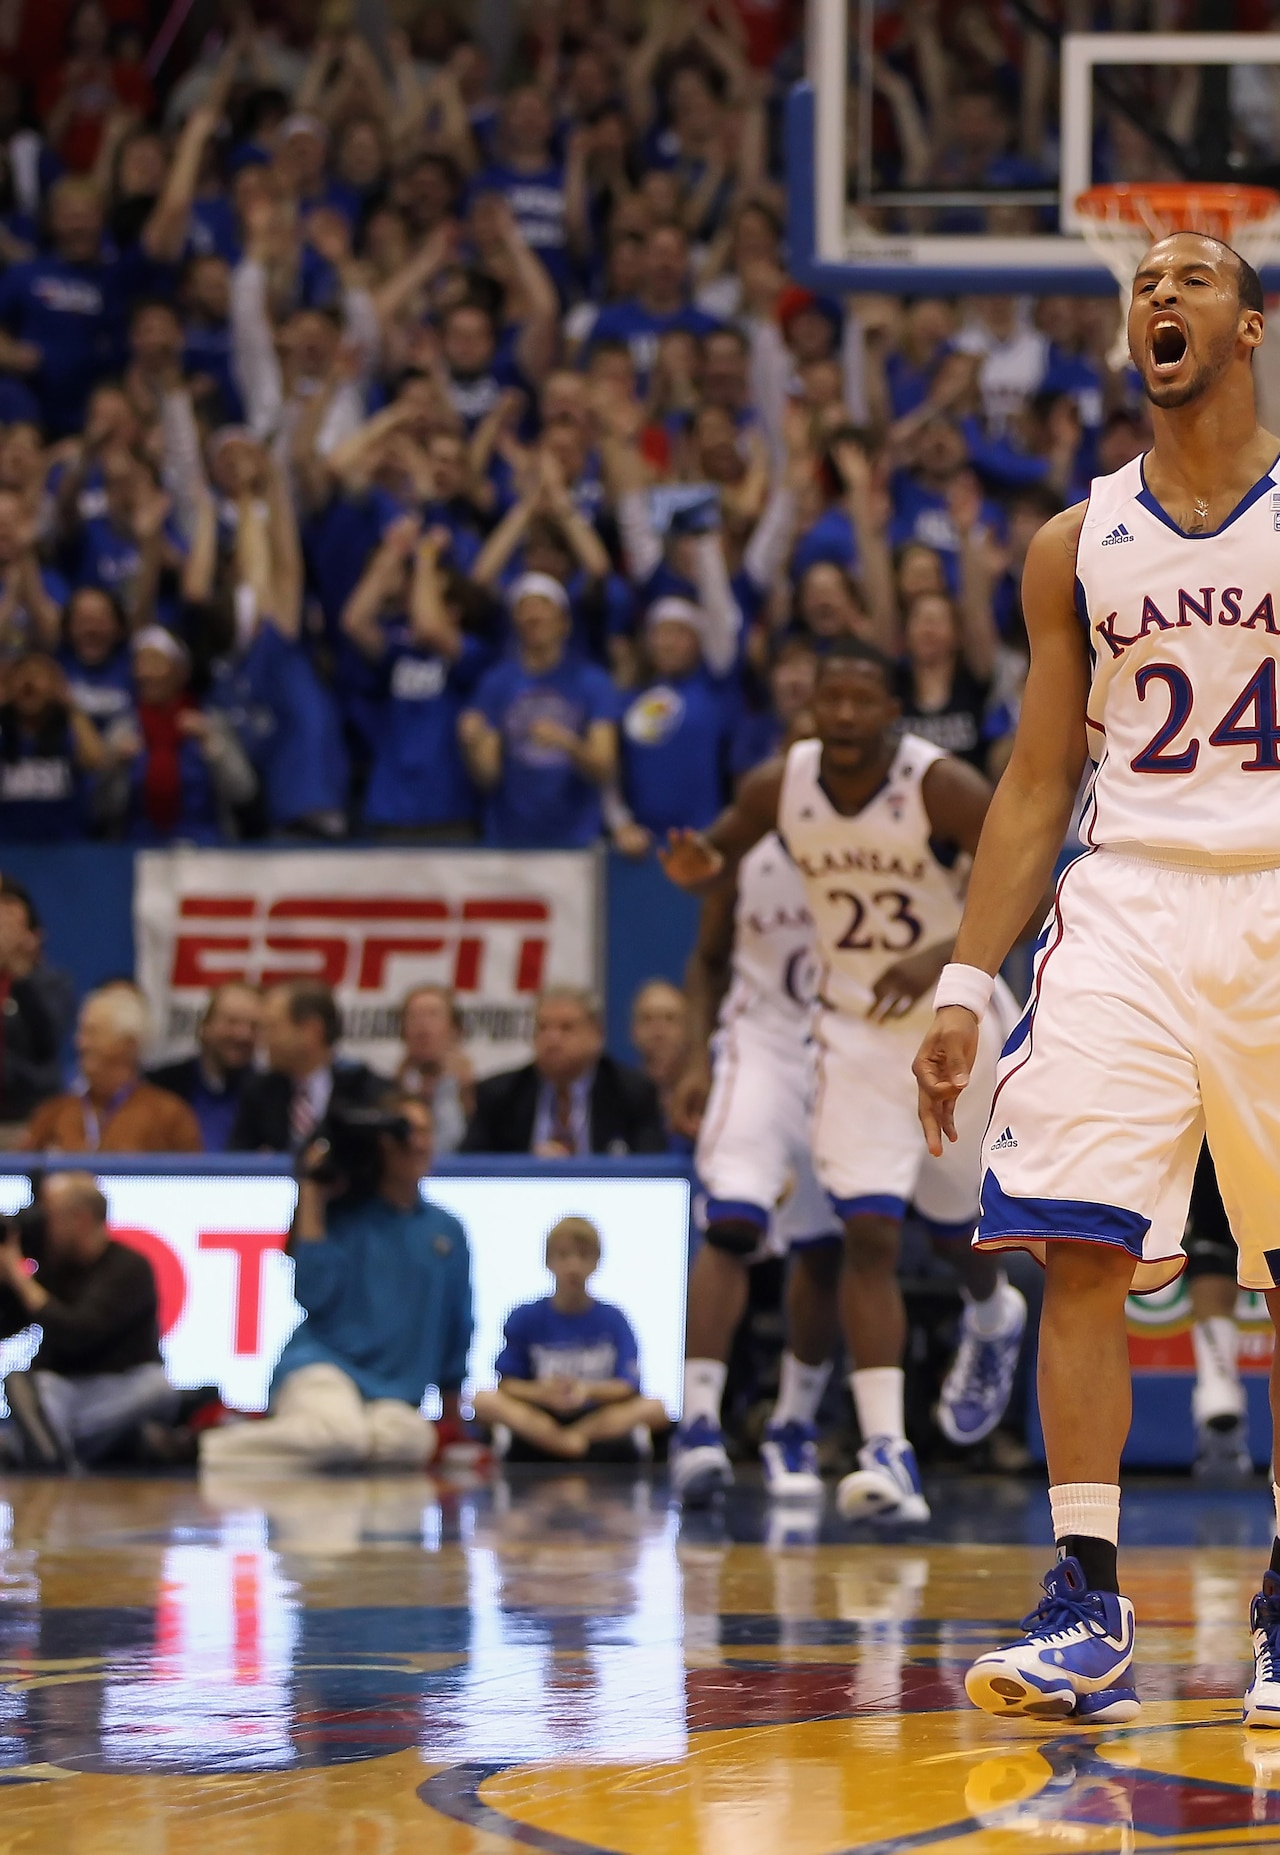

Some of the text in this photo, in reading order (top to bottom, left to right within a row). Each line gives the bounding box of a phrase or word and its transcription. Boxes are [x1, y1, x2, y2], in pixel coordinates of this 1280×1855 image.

[1101, 534, 1135, 547] adidas
[799, 849, 926, 880] KANSAS
[827, 887, 923, 951] 23
[170, 896, 551, 992] ESPN
[990, 1139, 1019, 1151] adidas
